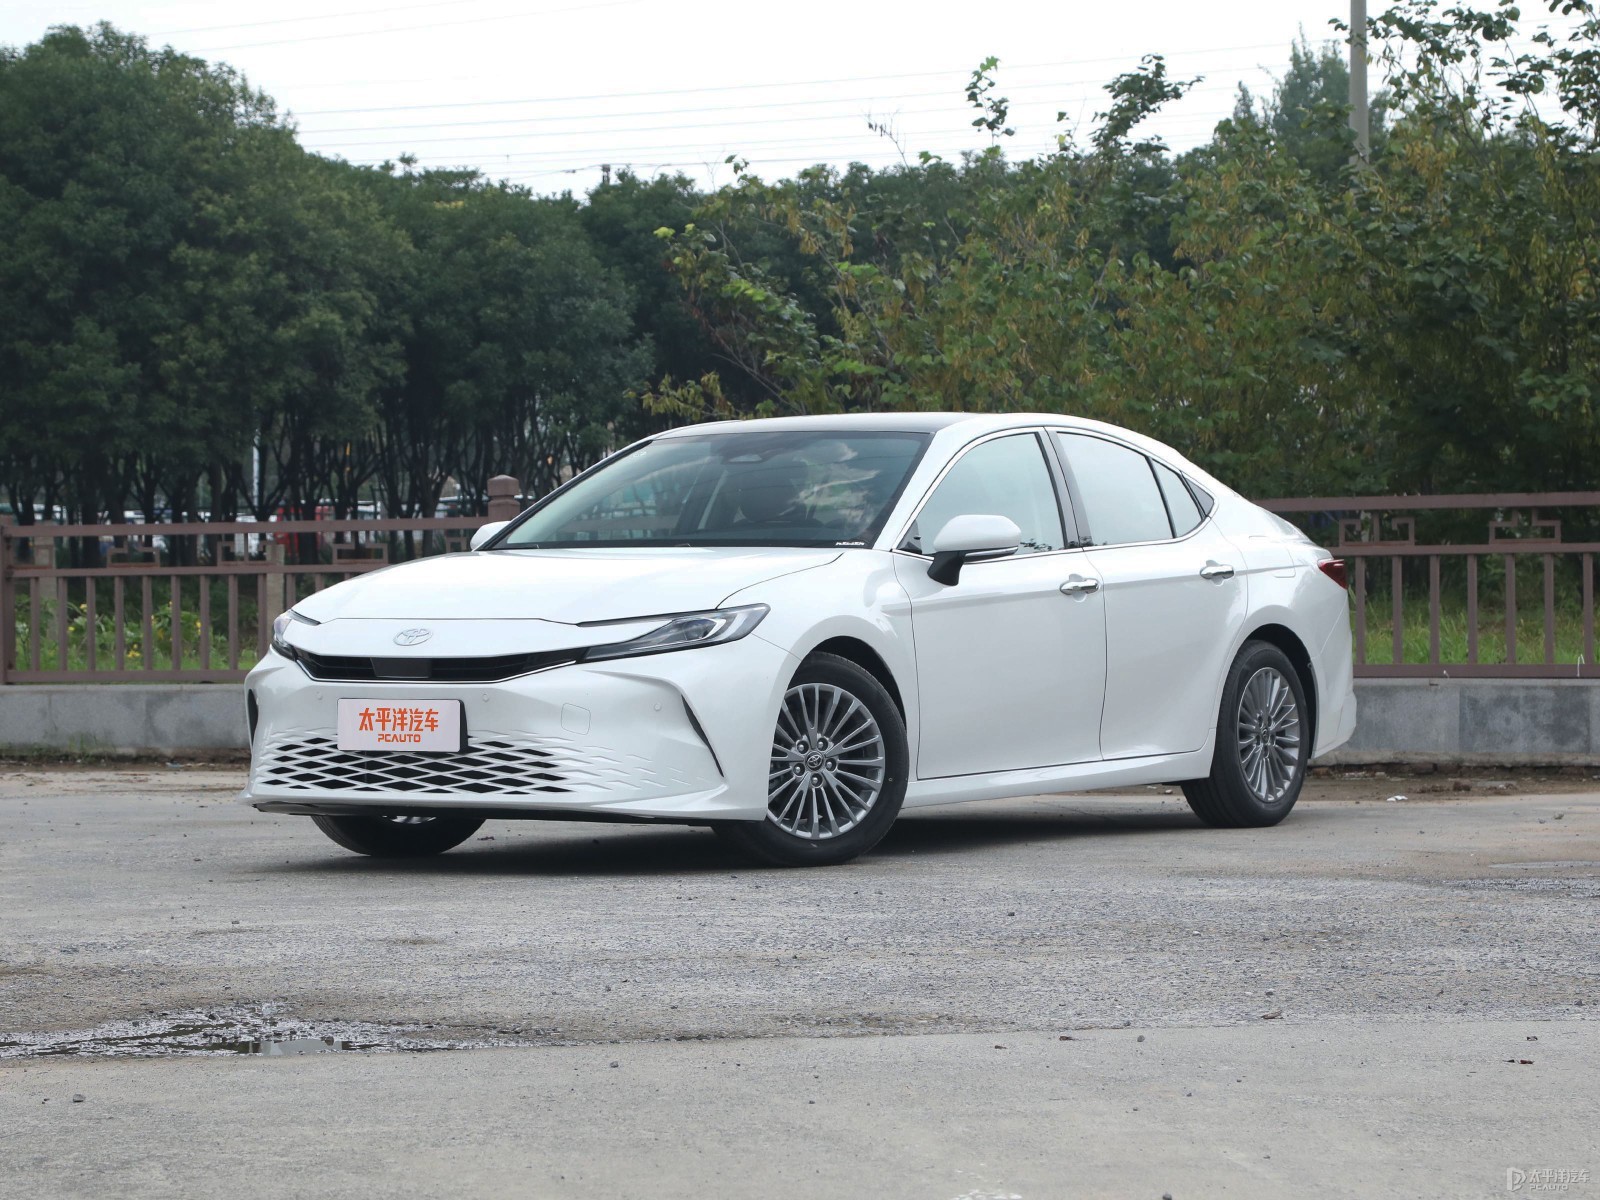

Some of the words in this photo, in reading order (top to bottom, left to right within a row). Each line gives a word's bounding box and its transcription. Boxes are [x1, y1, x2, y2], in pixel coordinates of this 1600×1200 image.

[359, 708, 439, 731] 太平洋汽车
[378, 734, 421, 742] PCAUTO
